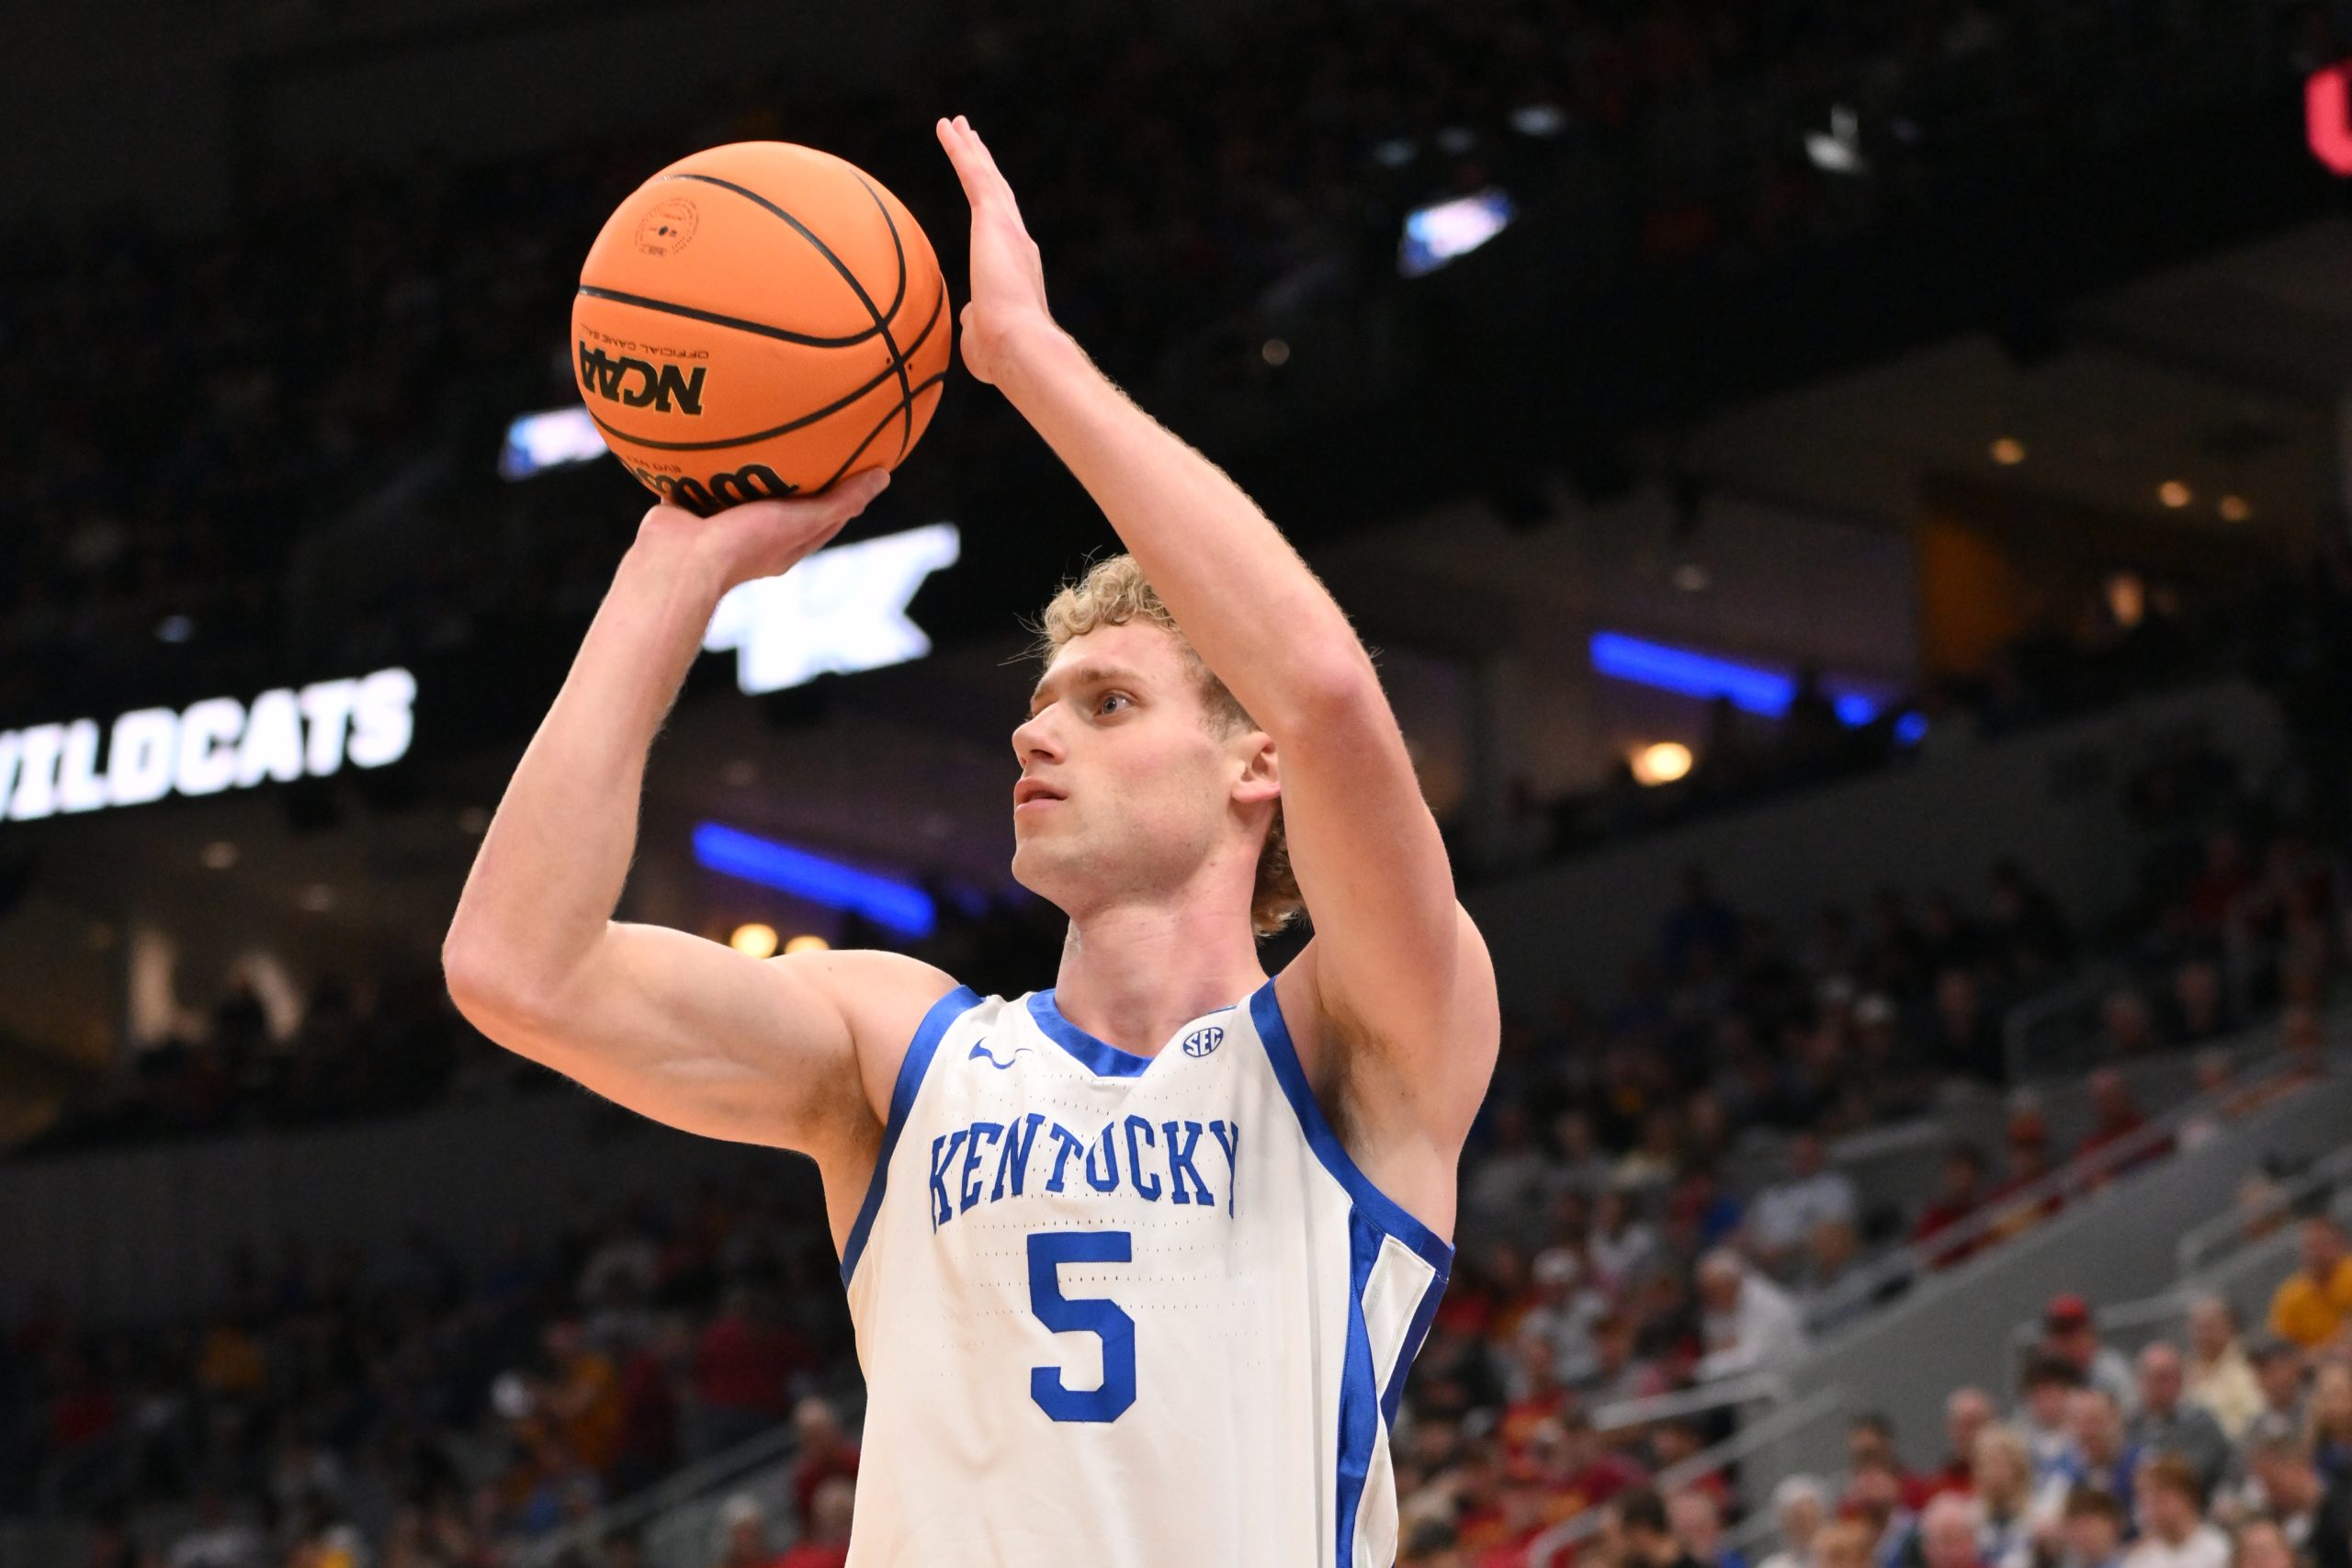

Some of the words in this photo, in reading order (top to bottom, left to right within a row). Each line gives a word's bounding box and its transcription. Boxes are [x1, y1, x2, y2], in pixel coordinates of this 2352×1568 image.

[579, 339, 707, 416] NCAA
[640, 344, 709, 359] OFFICIAL
[0, 667, 417, 823] ILDCATS
[1183, 1027, 1224, 1058] SEC
[930, 1112, 1238, 1235] KENTUCKY
[1026, 1231, 1136, 1423] 5
